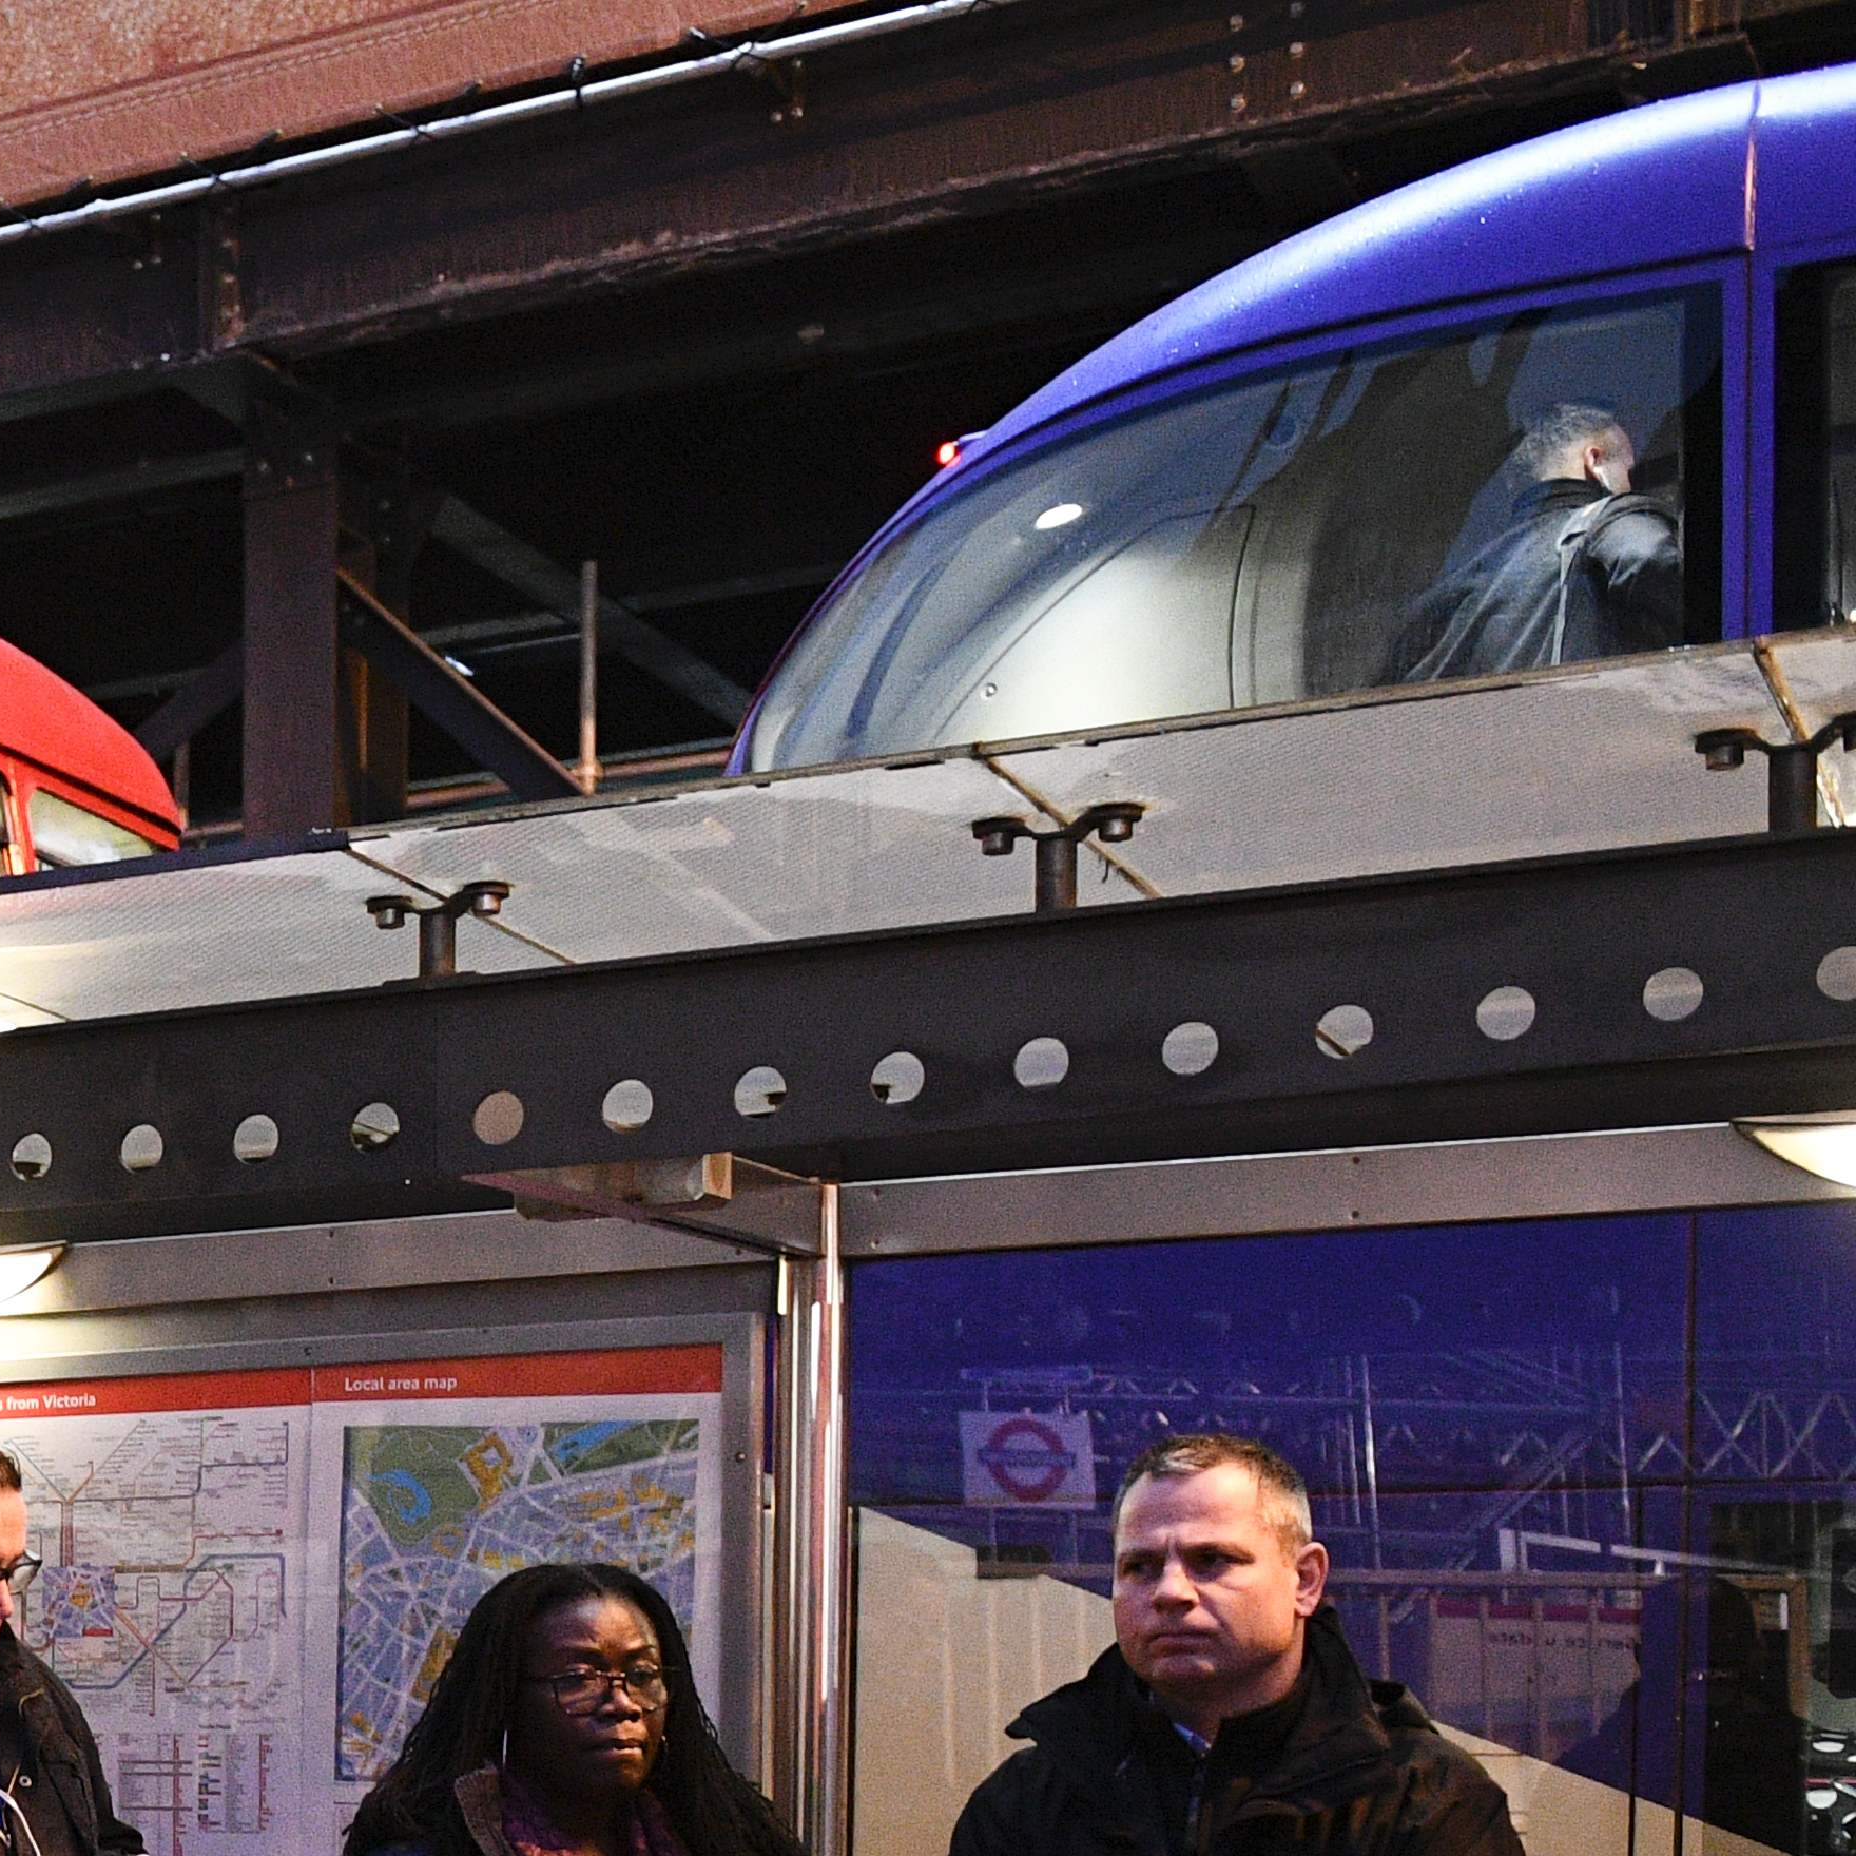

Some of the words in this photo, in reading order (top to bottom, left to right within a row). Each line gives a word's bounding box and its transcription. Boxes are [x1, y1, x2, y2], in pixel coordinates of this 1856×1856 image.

[344, 1376, 384, 1392] Local
[388, 1378, 420, 1391] area
[424, 1377, 458, 1392] map
[6, 1395, 39, 1411] from
[42, 1393, 97, 1409] Victoria
